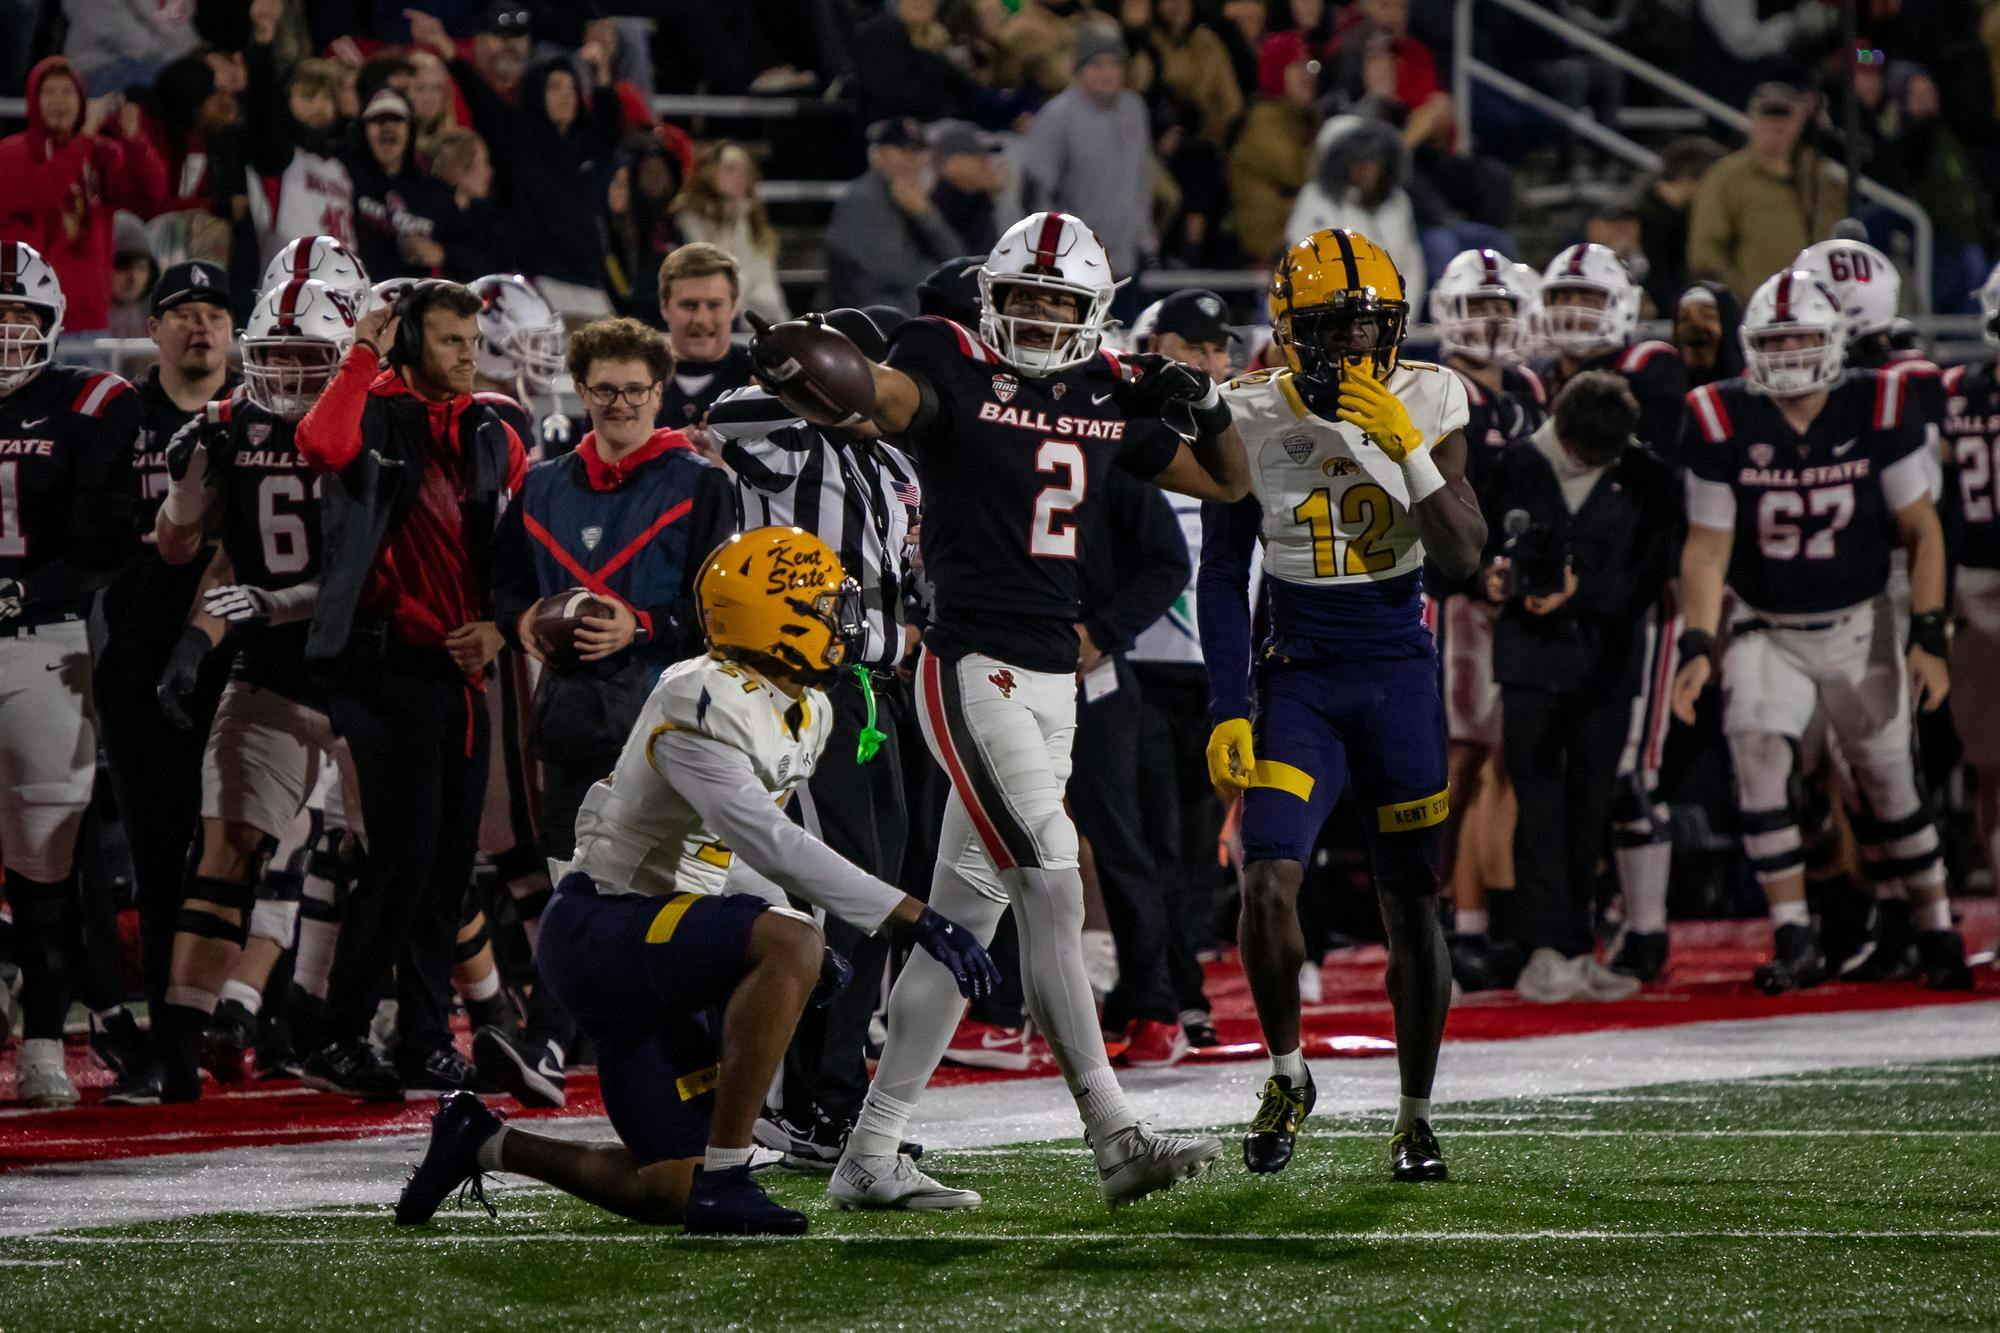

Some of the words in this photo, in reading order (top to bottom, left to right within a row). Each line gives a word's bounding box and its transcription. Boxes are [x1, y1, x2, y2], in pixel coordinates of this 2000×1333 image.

[1828, 249, 1871, 283] 60
[992, 380, 1018, 393] MAC
[977, 399, 1053, 433] BALL
[1054, 414, 1127, 442] STATE
[233, 450, 294, 468] BALL
[1286, 443, 1313, 455] MAC
[1332, 461, 1348, 477] K
[1738, 467, 1800, 488] BALL
[1800, 457, 1872, 487] STATE
[1028, 437, 1088, 561] 2
[1292, 482, 1397, 578] 12
[1757, 483, 1856, 562] 67
[767, 546, 823, 569] Kent
[766, 564, 833, 595] State
[1393, 805, 1428, 825] KENT
[839, 1159, 877, 1194] NIKE
